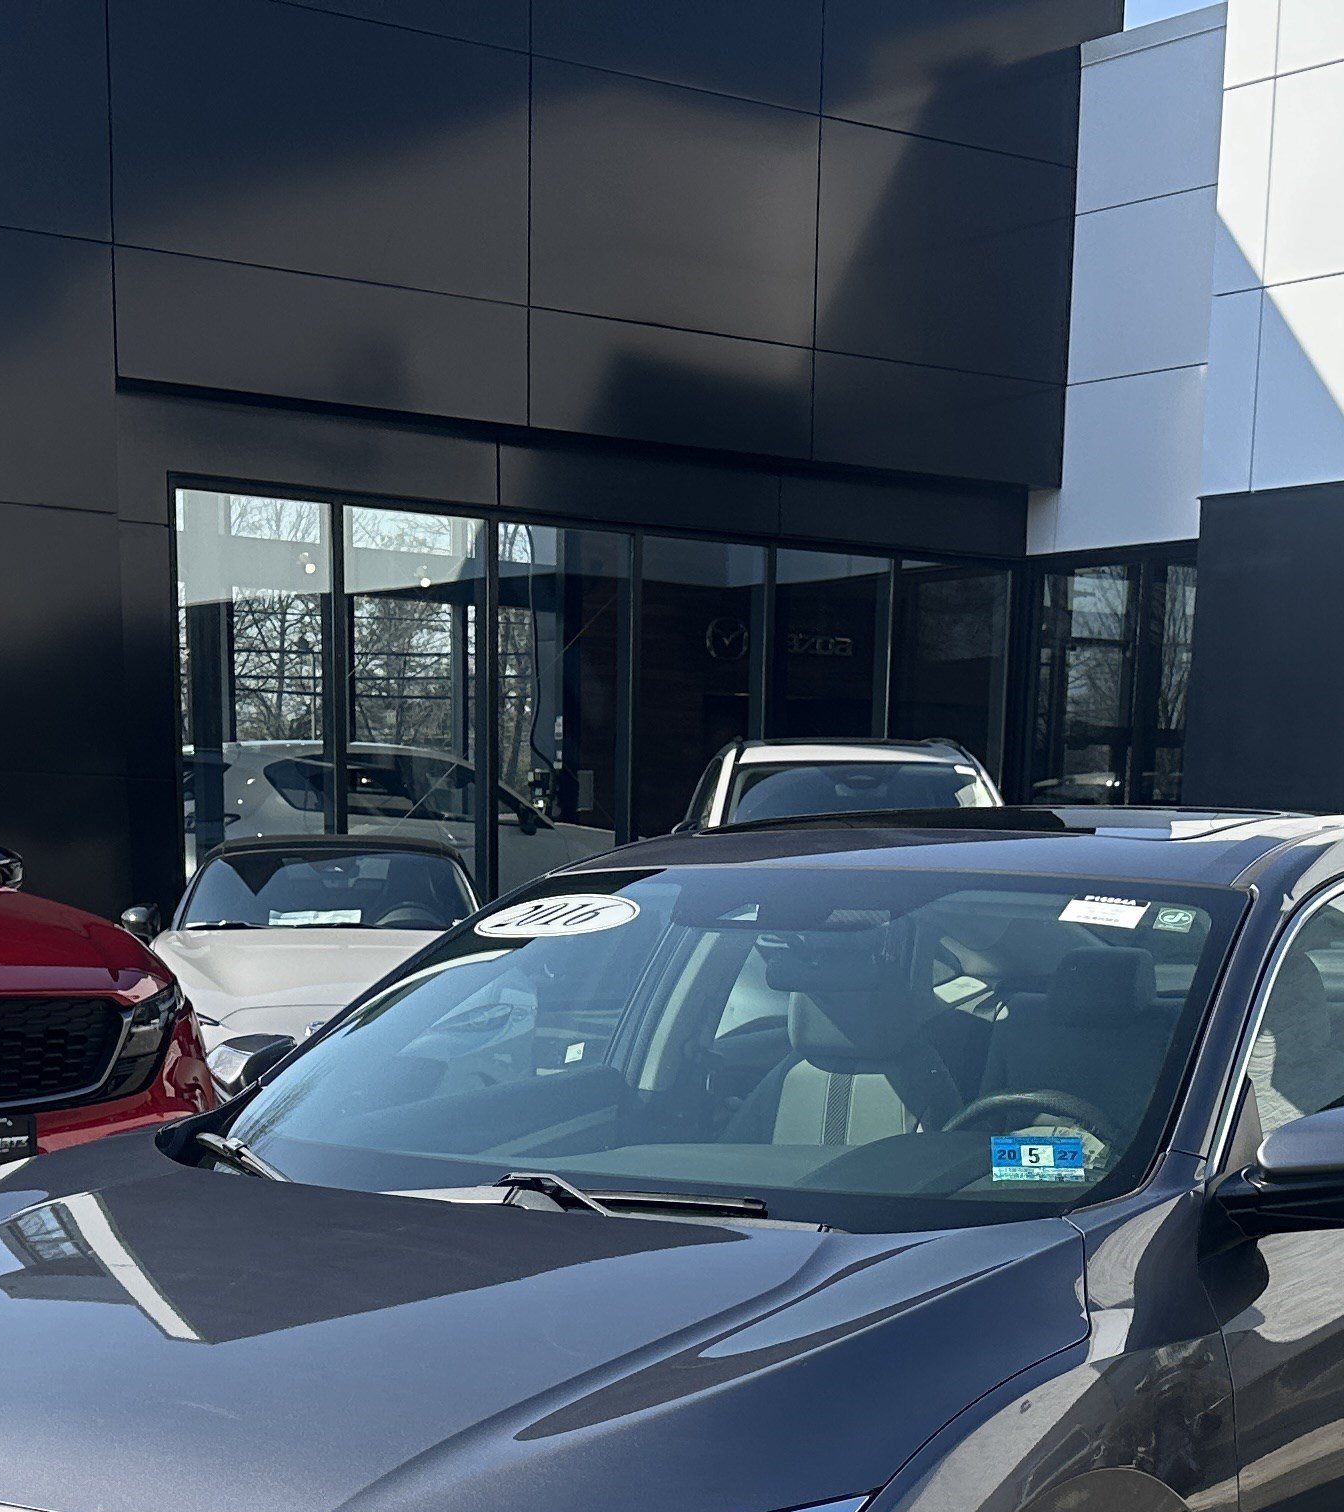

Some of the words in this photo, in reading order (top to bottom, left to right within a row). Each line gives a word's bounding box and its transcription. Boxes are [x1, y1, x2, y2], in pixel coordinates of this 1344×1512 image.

[997, 1149, 1016, 1160] 20
[1028, 1148, 1040, 1164] 5
[1057, 1150, 1078, 1161] 27
